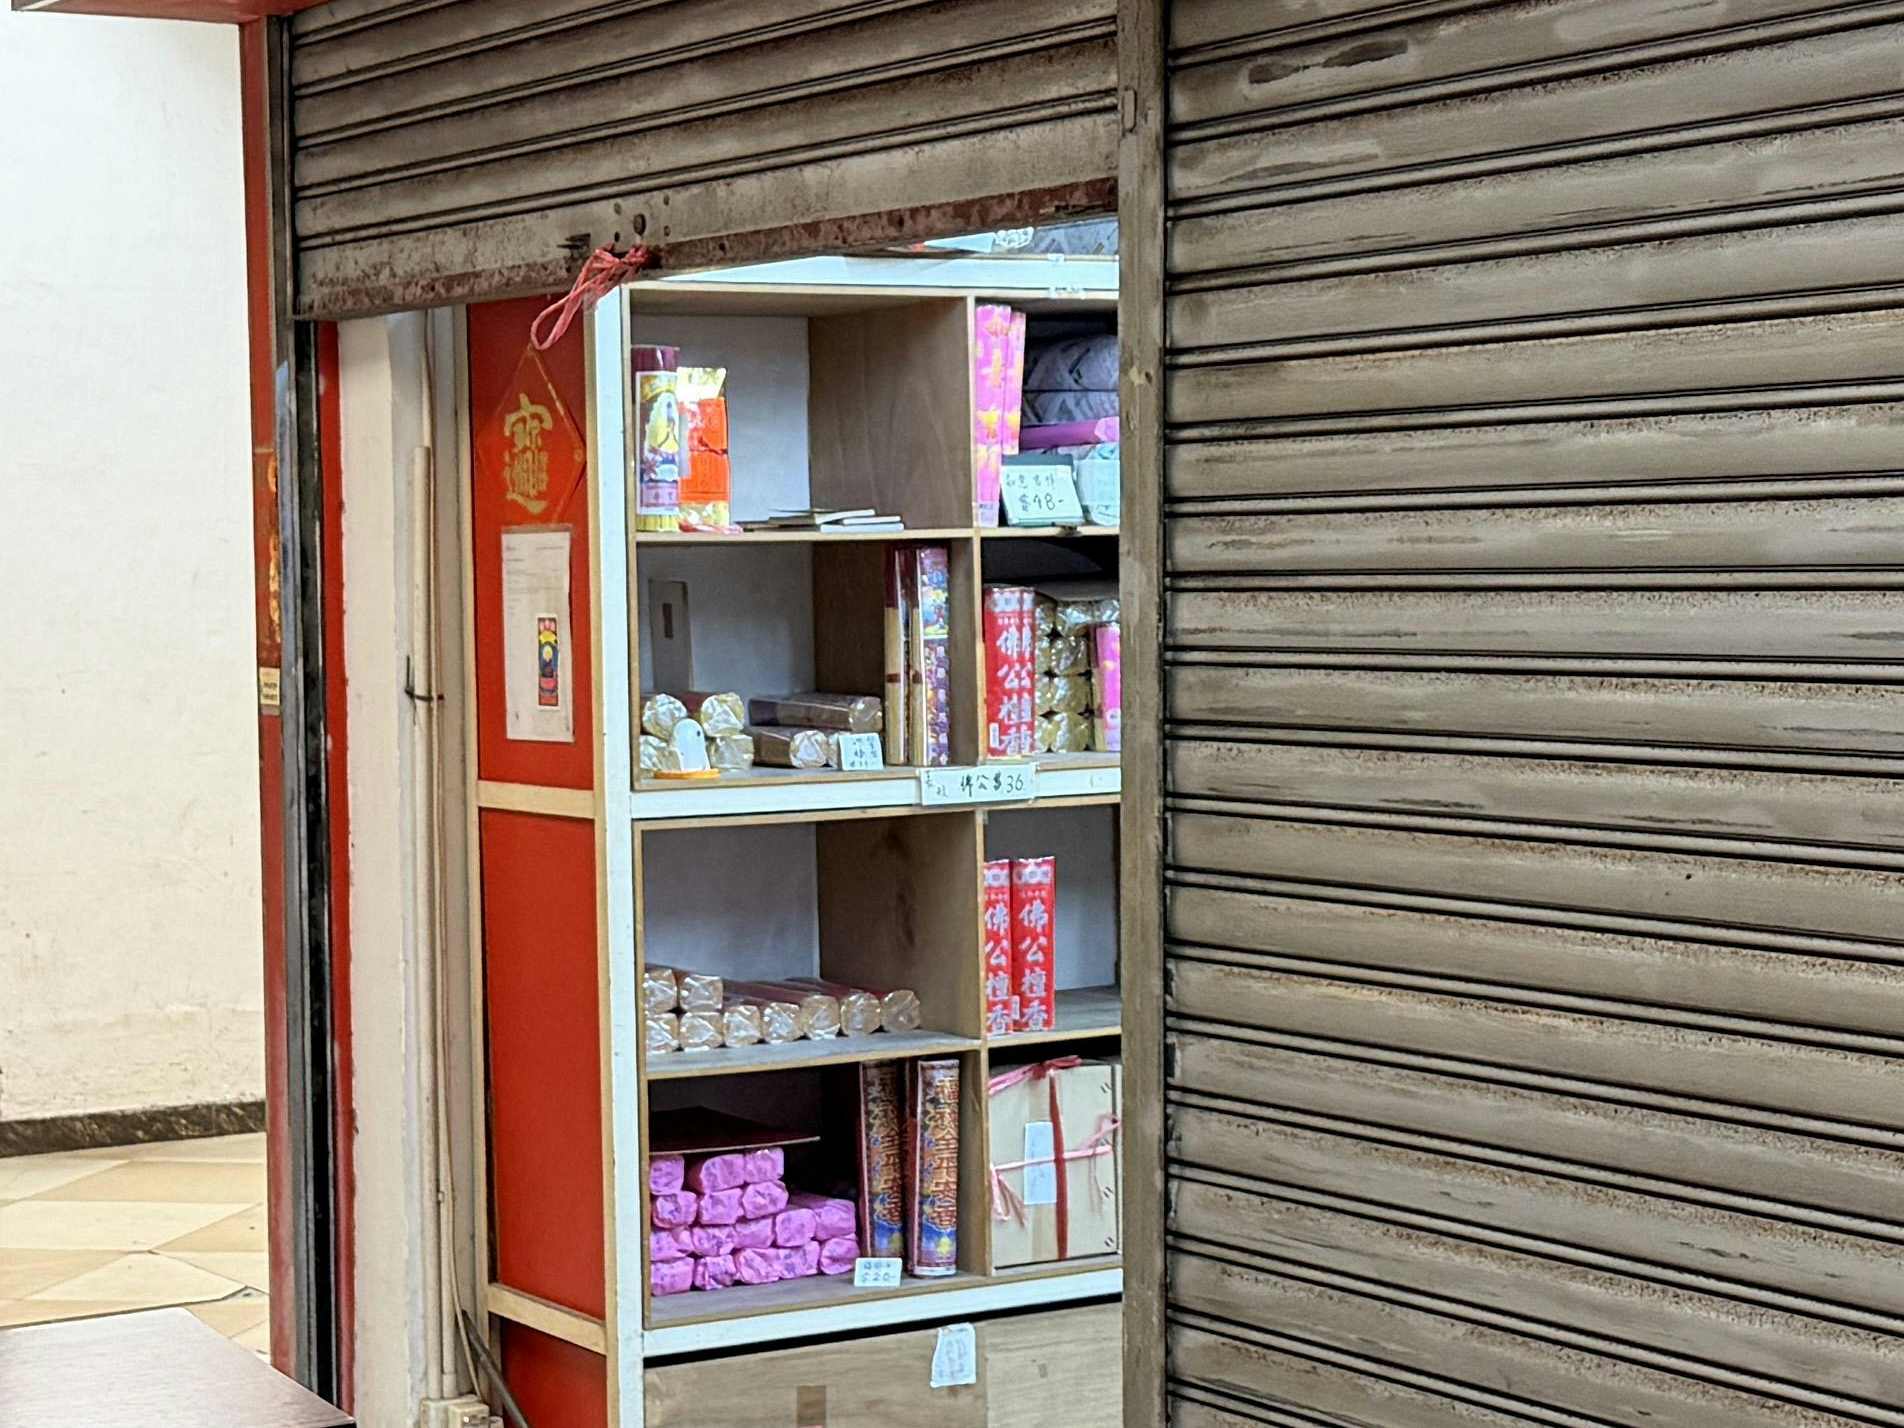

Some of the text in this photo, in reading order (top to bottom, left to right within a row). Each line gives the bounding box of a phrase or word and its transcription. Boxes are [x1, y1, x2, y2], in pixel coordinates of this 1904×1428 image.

[986, 901, 1009, 1034] 佛公檀香
[1019, 899, 1049, 1031] 佛公檀香
